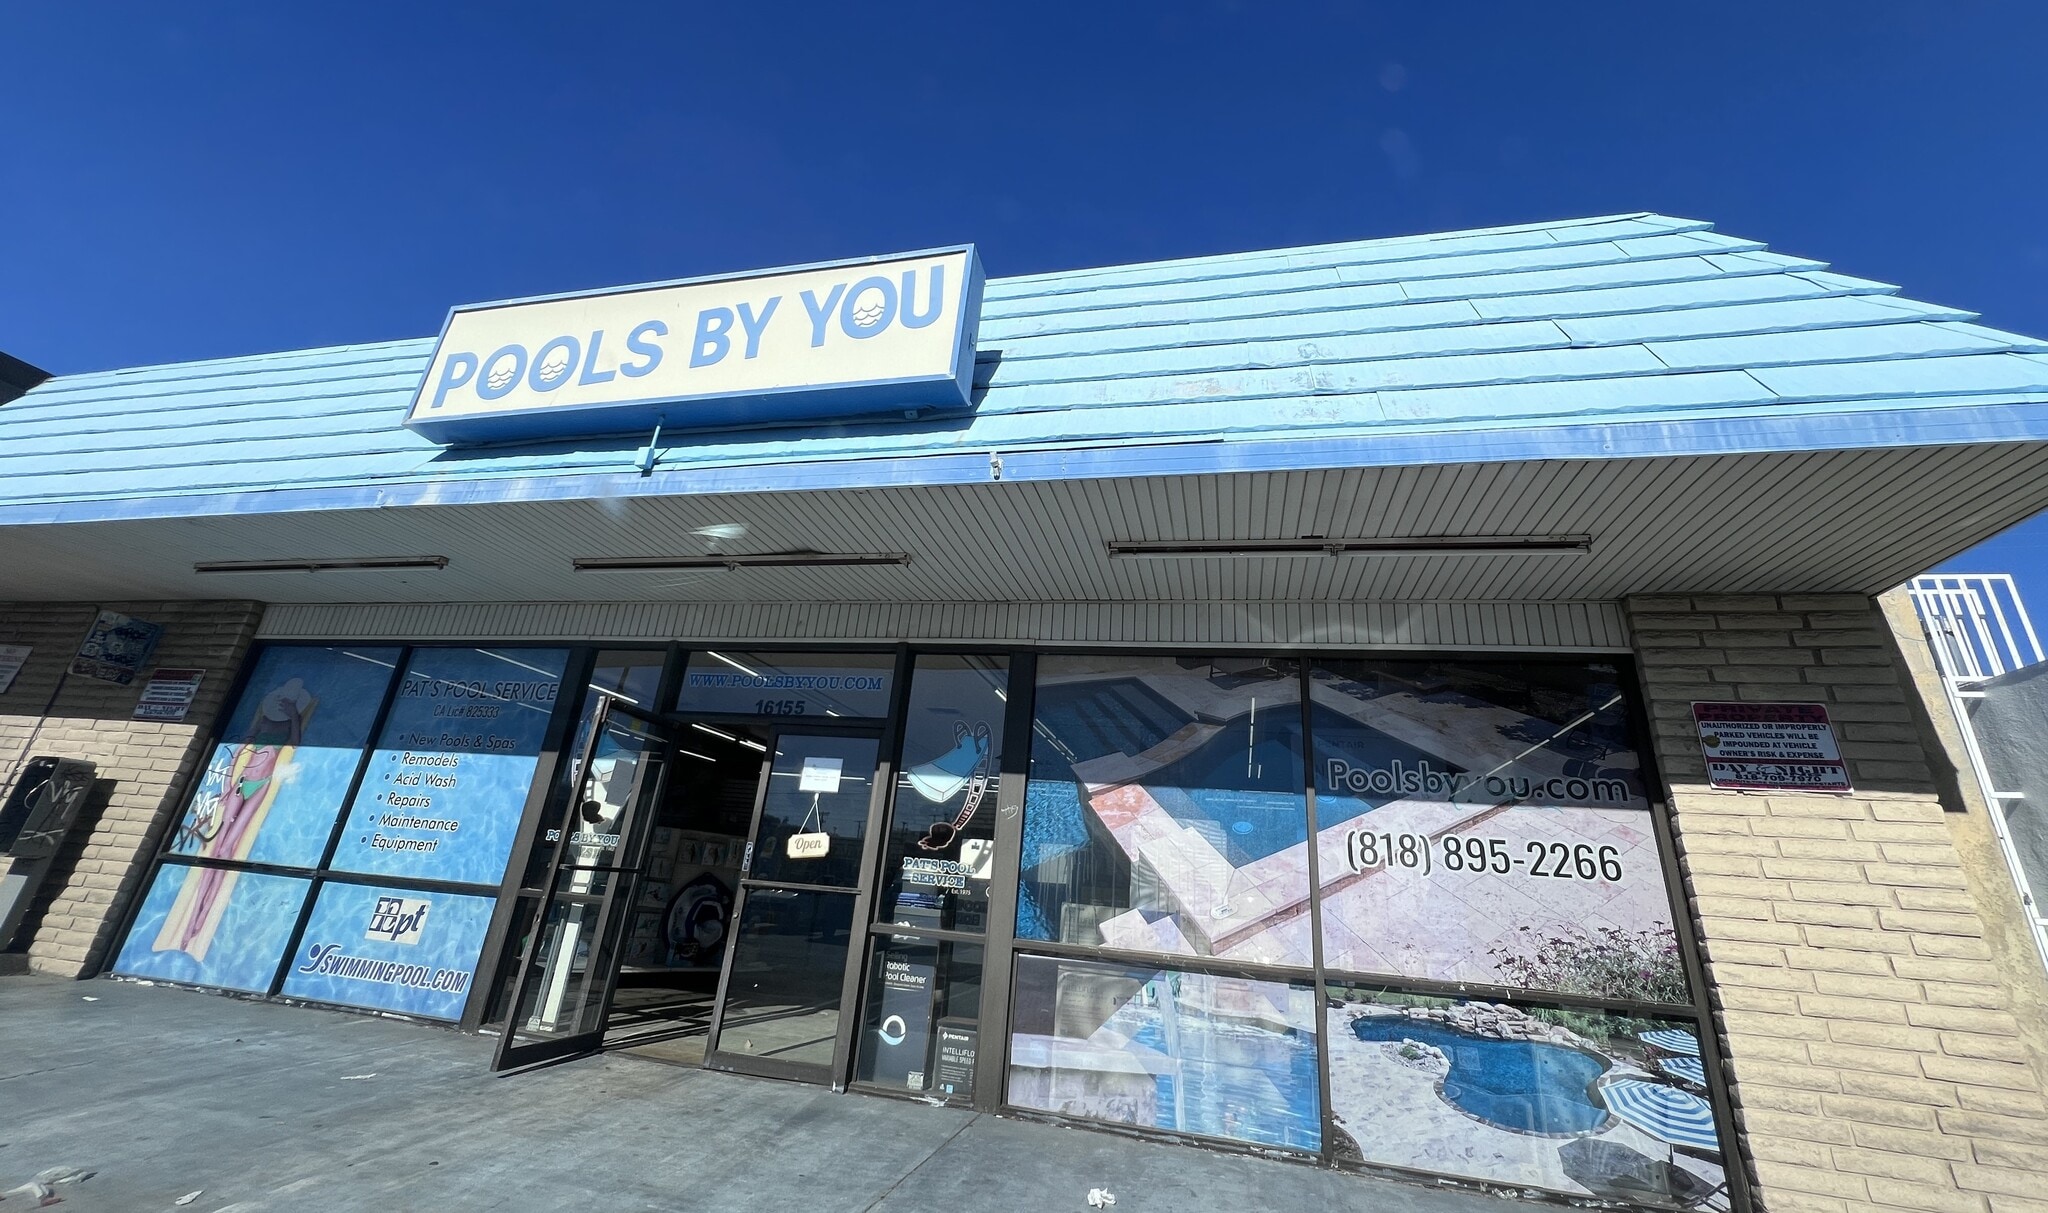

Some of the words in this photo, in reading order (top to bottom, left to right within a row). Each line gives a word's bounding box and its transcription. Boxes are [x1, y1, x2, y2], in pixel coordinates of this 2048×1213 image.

[430, 320, 668, 408] POOLS
[689, 296, 784, 369] BY
[800, 264, 945, 348] YOU
[689, 674, 884, 690] WWW.POOLSBYYOU.COM
[401, 680, 441, 697] PAT'S
[444, 680, 487, 699] POOL
[494, 682, 558, 701] SERVICE
[433, 705, 445, 717] CA
[466, 705, 500, 719] 825333
[755, 700, 805, 715] 16155
[1703, 704, 1815, 714] PRIVATE
[1699, 713, 1824, 723] PROPERTY
[1701, 722, 1760, 730] UNAUTHORIZED
[1775, 723, 1827, 731] IMPROPERLY
[408, 732, 436, 745] New
[439, 734, 470, 748] Pools
[474, 735, 482, 748] &
[486, 735, 515, 751] Spas
[1714, 731, 1745, 739] PARKED
[1748, 732, 1785, 740] VEHICLES
[1783, 742, 1818, 750] VEHICLE
[401, 752, 459, 767] Remodels
[1712, 763, 1749, 772] DAY
[1776, 765, 1841, 775] NIGHT
[393, 772, 420, 786] Acid
[426, 773, 456, 787] Wash
[387, 792, 431, 809] Repairs
[378, 813, 459, 831] Maintenance
[371, 834, 438, 852] Equipment
[546, 830, 581, 842] POS
[598, 834, 619, 845] YOU
[794, 838, 823, 853] Open
[1347, 830, 1432, 876] (818)
[1443, 834, 1623, 882] 895-2266
[903, 857, 939, 871] PAT'S
[941, 861, 976, 875] POOL
[911, 873, 965, 888] SERVICE
[319, 954, 469, 992] SWIMMINGPOOL.COM
[900, 973, 927, 984] Cleaner
[948, 1033, 969, 1041] PENTAIR
[942, 1046, 975, 1058] INTELLIFLO
